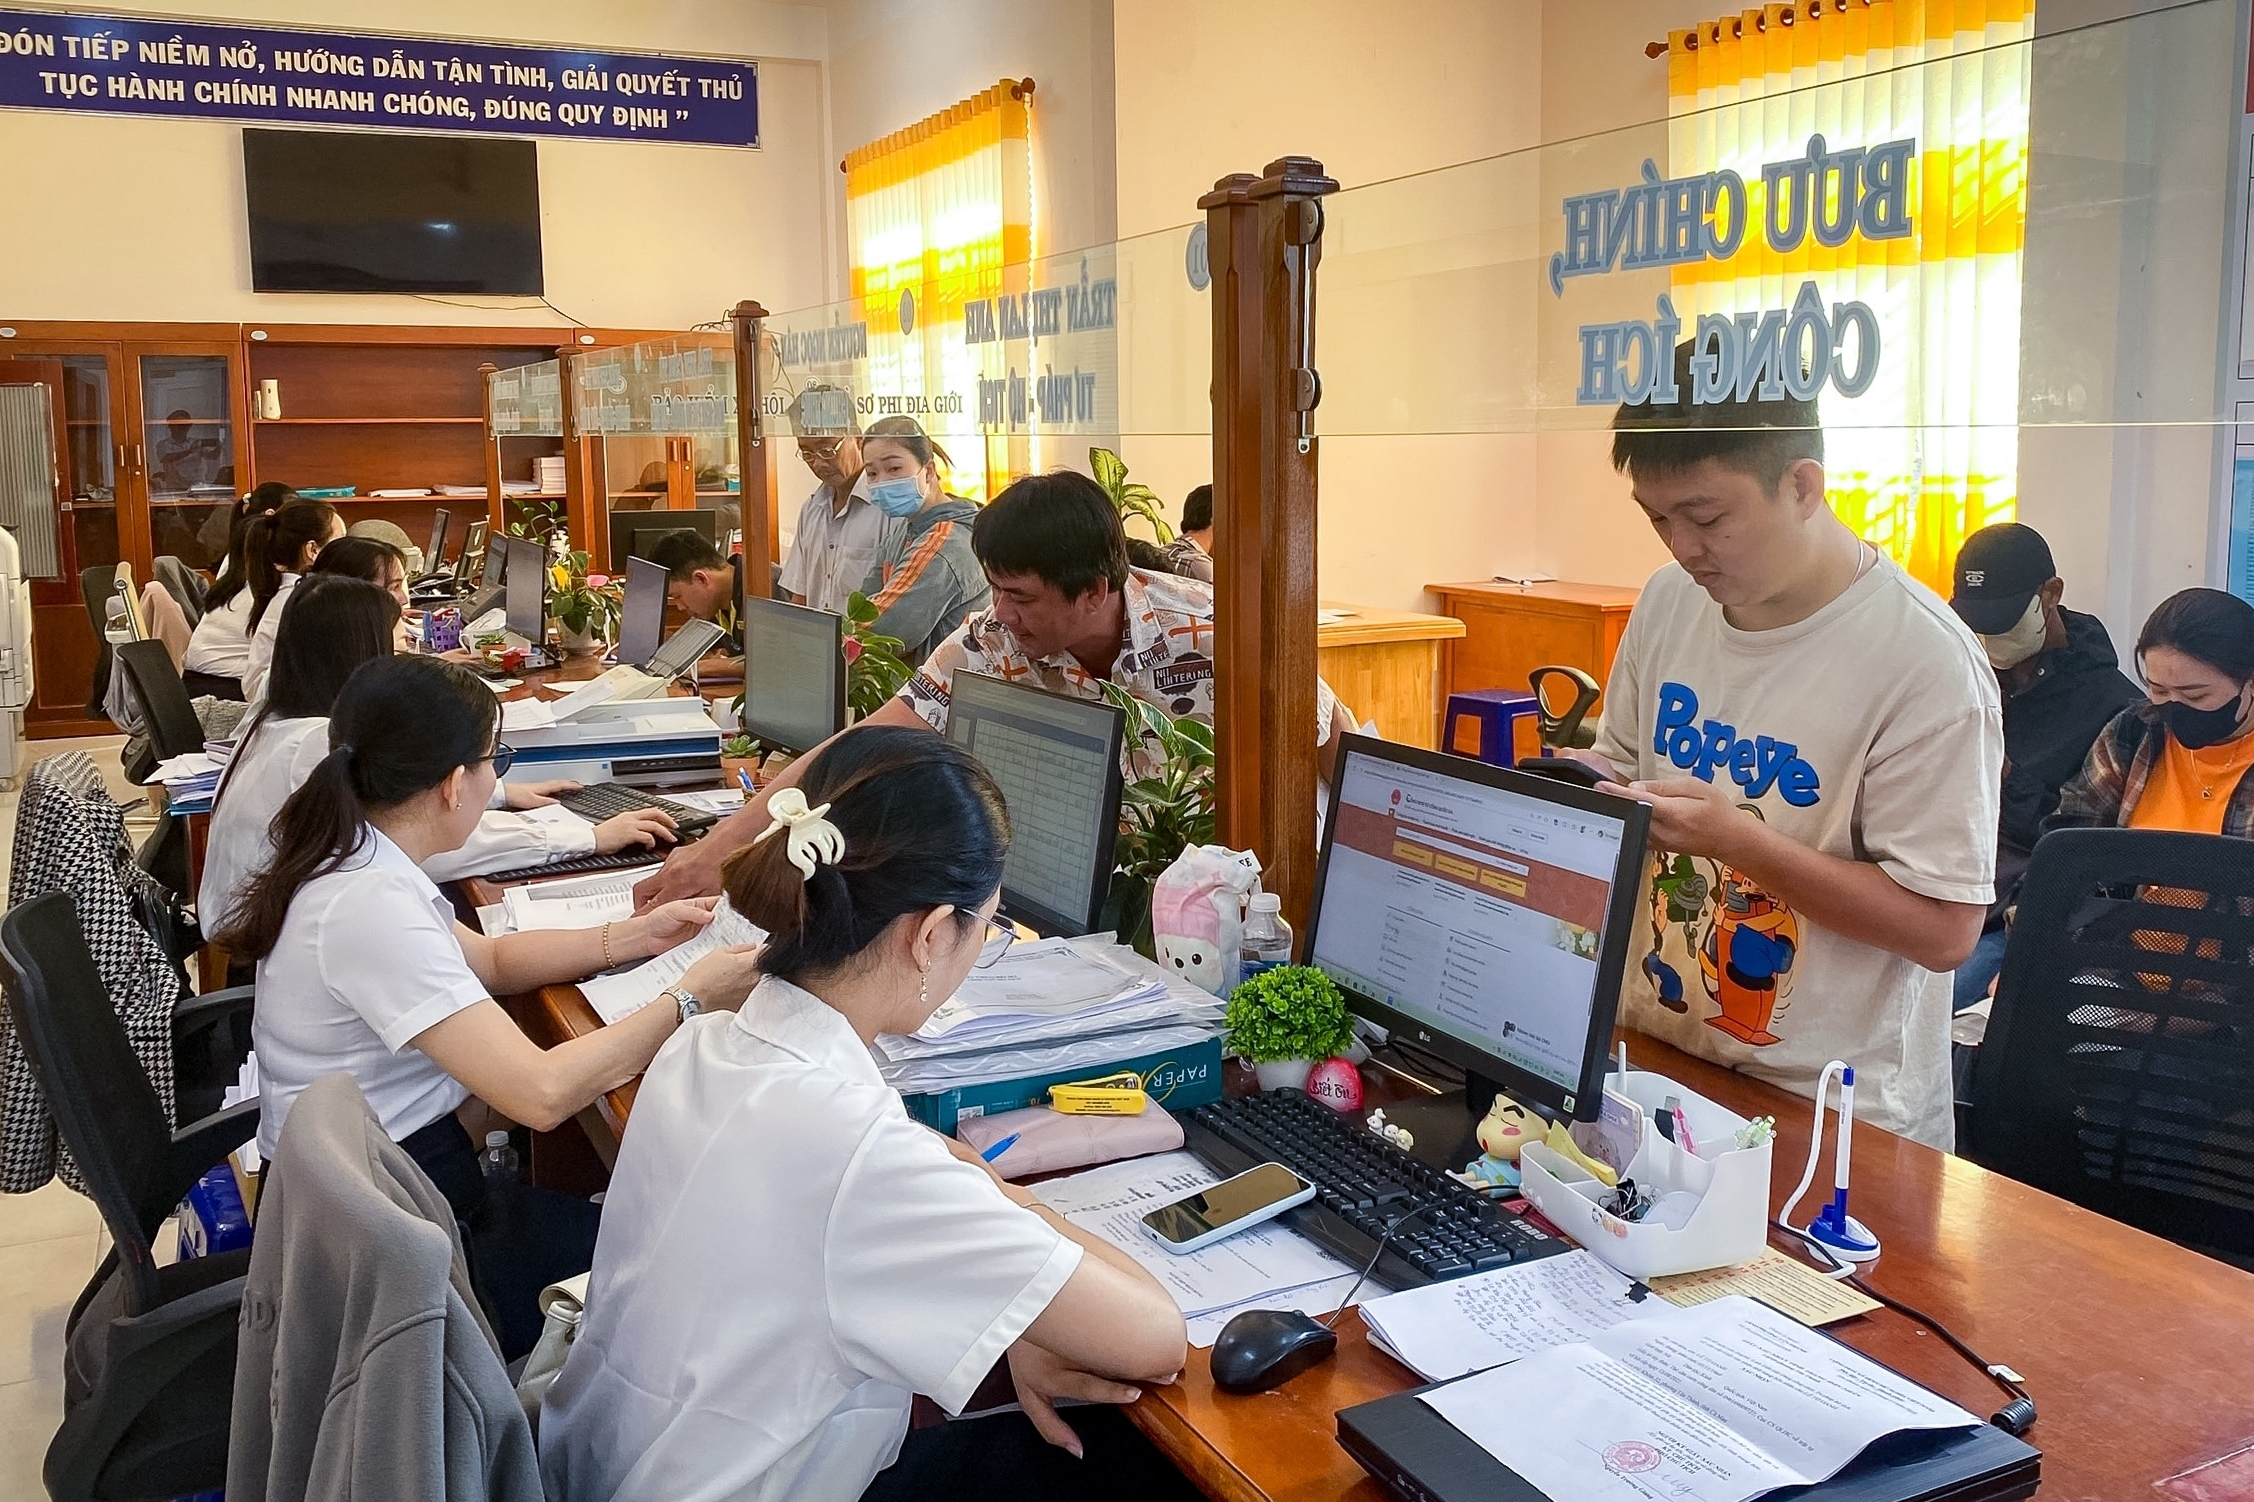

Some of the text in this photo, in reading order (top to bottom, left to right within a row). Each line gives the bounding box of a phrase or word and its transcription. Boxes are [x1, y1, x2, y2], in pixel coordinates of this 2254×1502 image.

[0, 28, 743, 101] ĐÓN TIẾP NIỀM NỞ, HƯỚNG DẪN TẬN TÌNH, GIẢI QUYẾT THỦ
[39, 71, 98, 100] TỤC
[107, 72, 185, 102] HÀNH
[194, 79, 277, 106] CHÍNH
[286, 87, 375, 113] NHANH
[383, 90, 476, 122] CHÓNG,
[484, 96, 551, 122] ĐÚNG
[558, 105, 604, 127] QUY
[613, 107, 668, 131] ĐỊNH
[857, 393, 874, 414] SƠ
[878, 395, 902, 414] PHI
[906, 396, 929, 418] ĐỊA
[934, 390, 962, 413] GIỚI
[1654, 681, 1821, 807] Popeye
[1153, 1063, 1207, 1088] PAPER
[1509, 1218, 1549, 1240] ROBO
